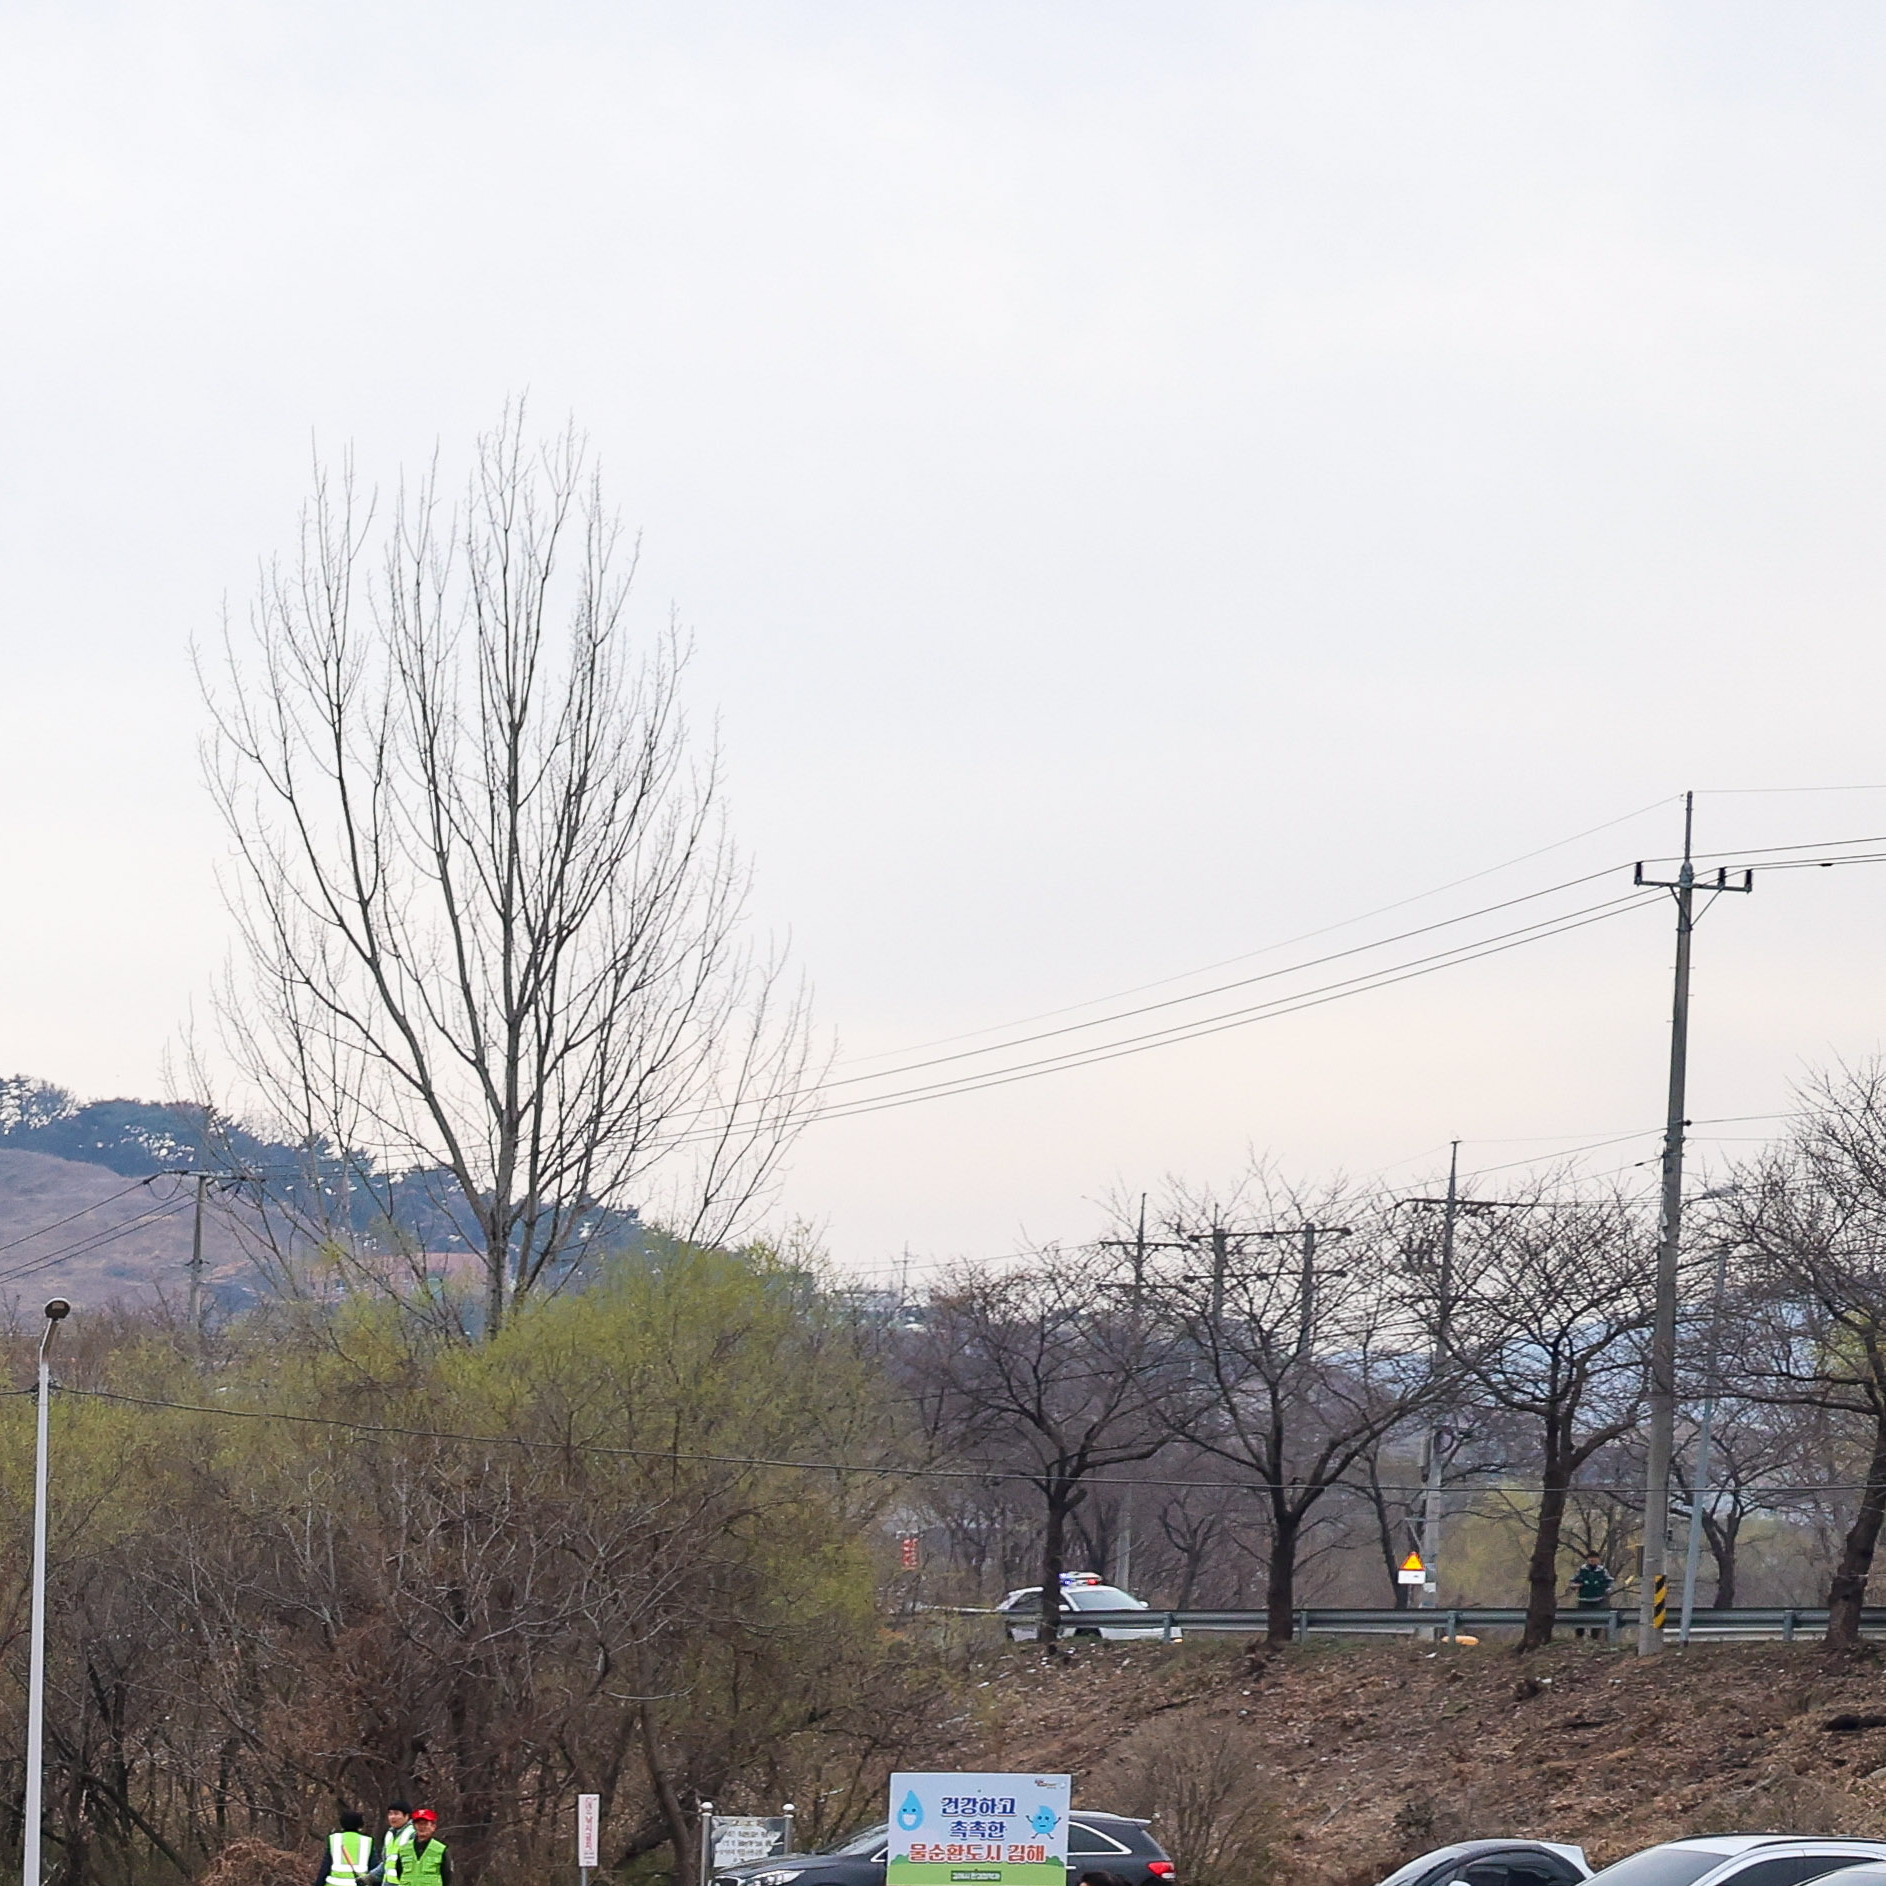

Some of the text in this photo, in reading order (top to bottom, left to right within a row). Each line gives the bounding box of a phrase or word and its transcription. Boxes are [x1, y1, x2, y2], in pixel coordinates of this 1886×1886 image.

[941, 1797, 1016, 1817] 건강하고
[950, 1821, 1006, 1840] 촉촉한
[909, 1843, 1046, 1863] 물순환도시 김해
